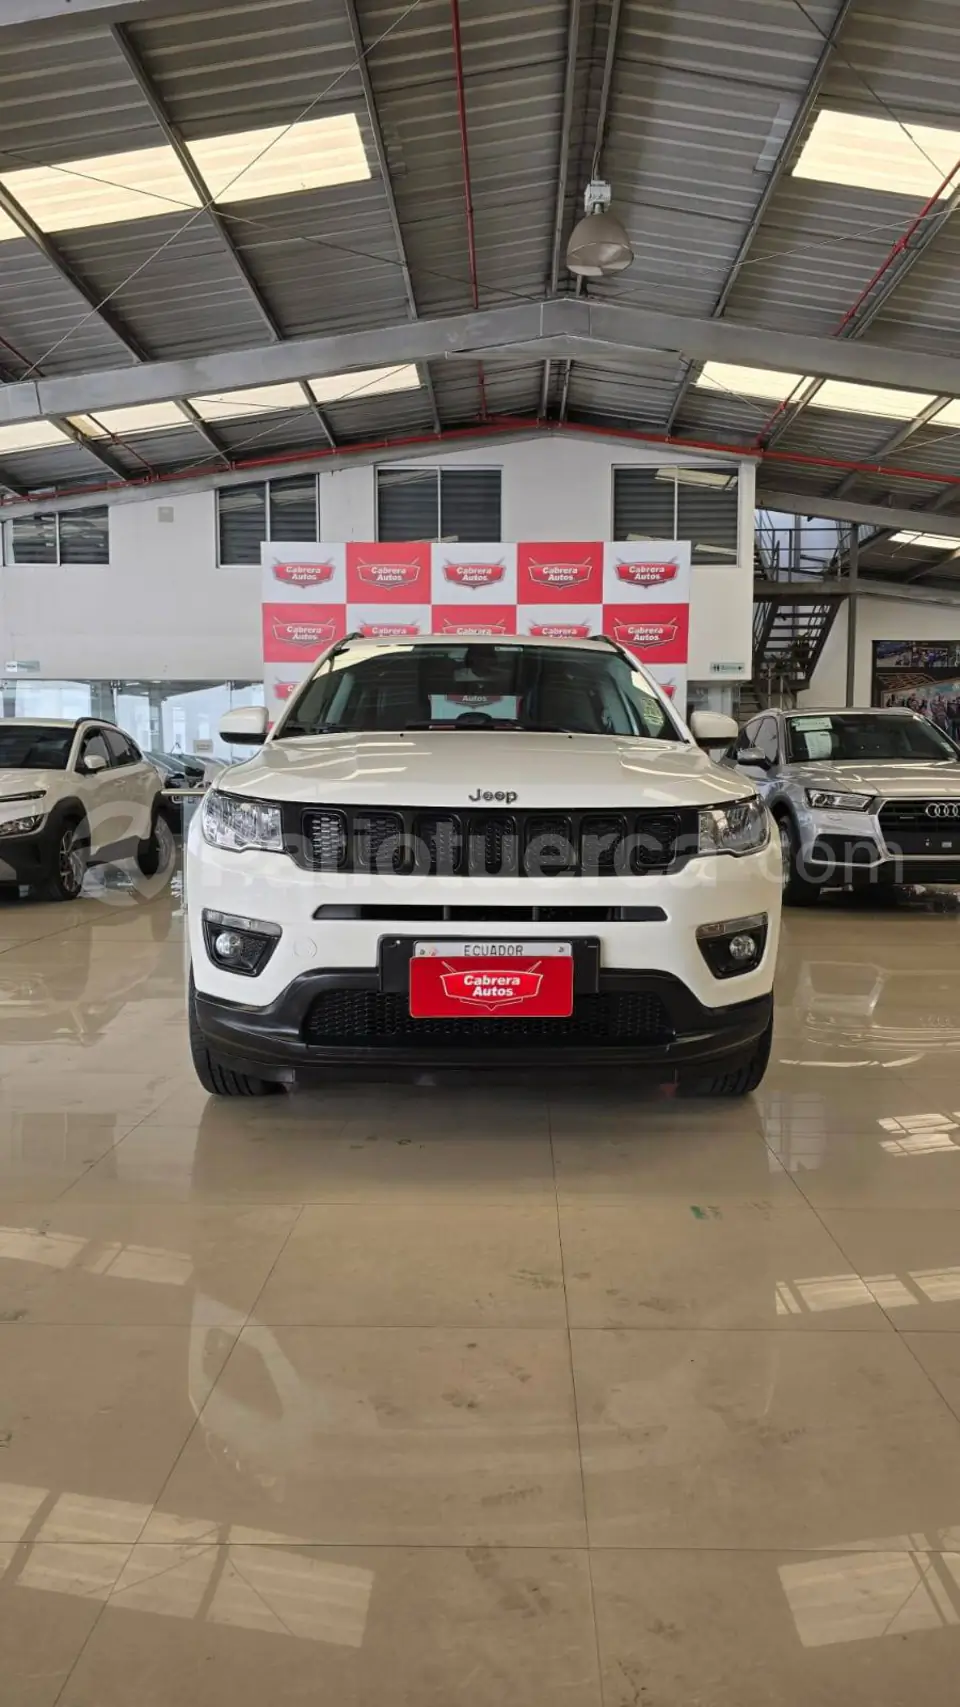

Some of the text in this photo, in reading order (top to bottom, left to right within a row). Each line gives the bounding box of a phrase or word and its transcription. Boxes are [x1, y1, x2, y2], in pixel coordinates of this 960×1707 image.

[286, 566, 321, 574] Cabrera
[371, 566, 406, 574] Cabrera
[456, 566, 492, 574] Cabrera
[542, 566, 578, 574] Cabrera
[286, 626, 322, 634] Cabrera
[372, 627, 407, 635] Cabrera
[541, 627, 577, 635] Cabrera
[634, 633, 659, 641] Autos
[468, 788, 519, 805] Jeep
[464, 944, 524, 957] ECUADOR
[464, 975, 521, 986] Cabrera
[472, 986, 514, 997] Autos
